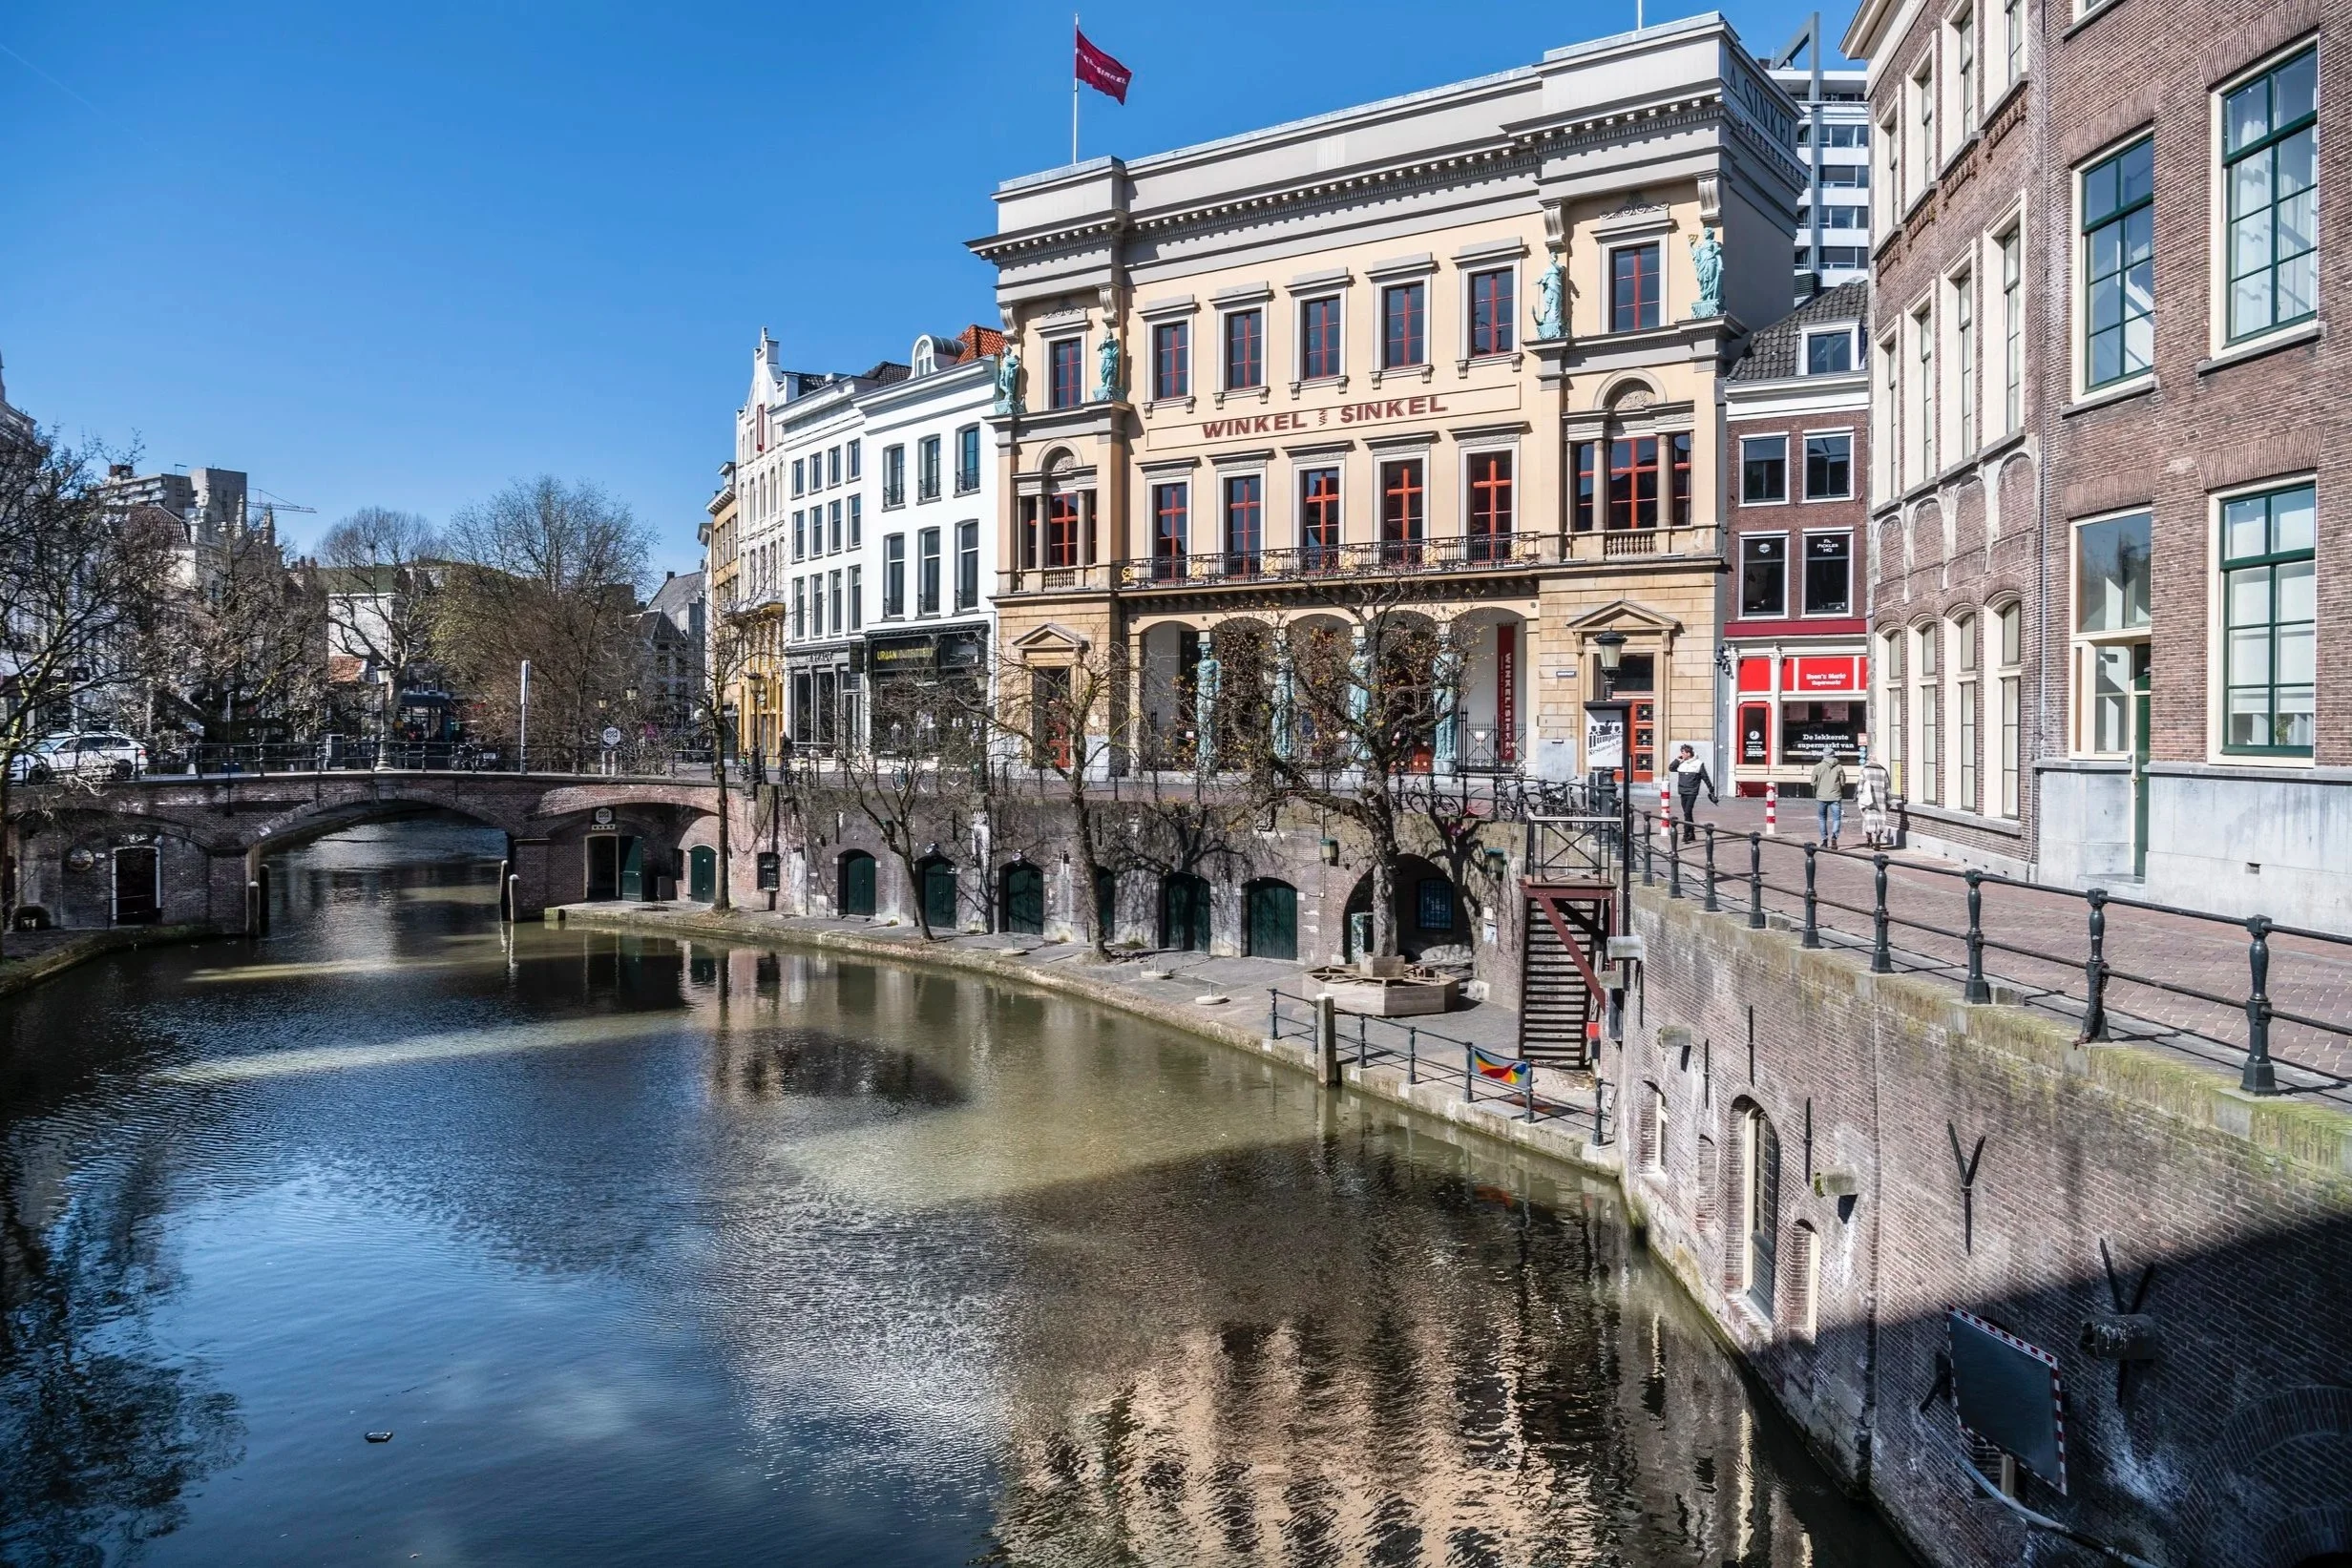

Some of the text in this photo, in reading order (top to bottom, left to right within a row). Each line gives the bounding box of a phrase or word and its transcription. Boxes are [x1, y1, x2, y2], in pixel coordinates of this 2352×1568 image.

[1203, 396, 1448, 438] WINKEL VAN SINKEL
